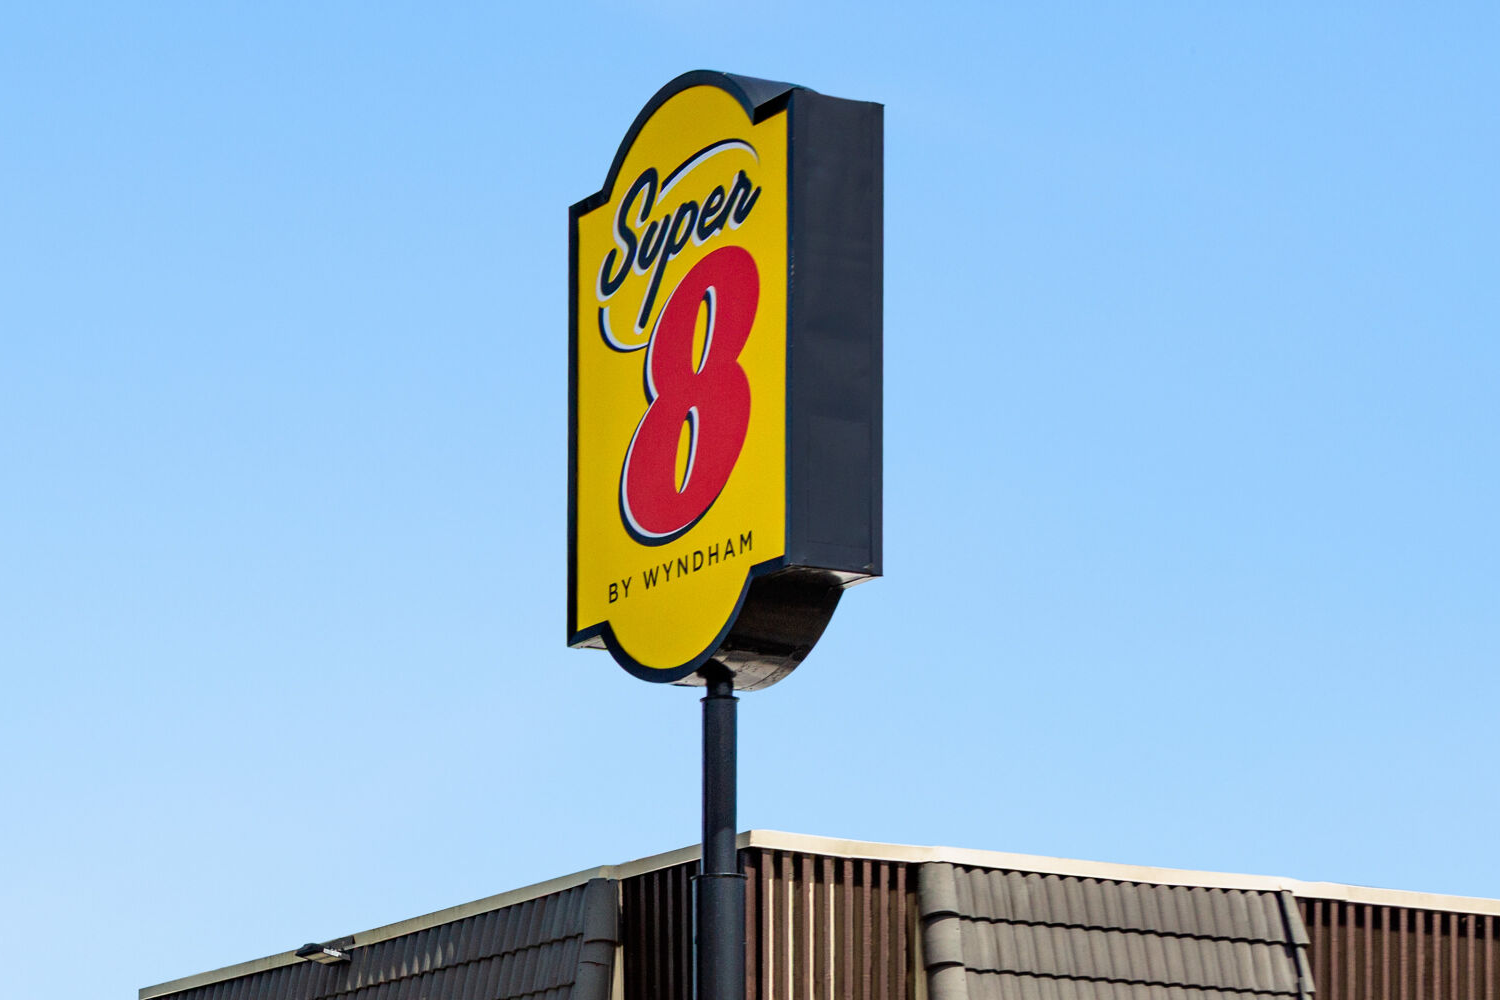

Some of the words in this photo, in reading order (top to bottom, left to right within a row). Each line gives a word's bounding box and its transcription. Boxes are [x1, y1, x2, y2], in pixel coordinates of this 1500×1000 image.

[596, 166, 763, 335] Super
[618, 245, 761, 547] 8
[608, 576, 632, 604] BY
[643, 530, 753, 590] WYNDHAM
